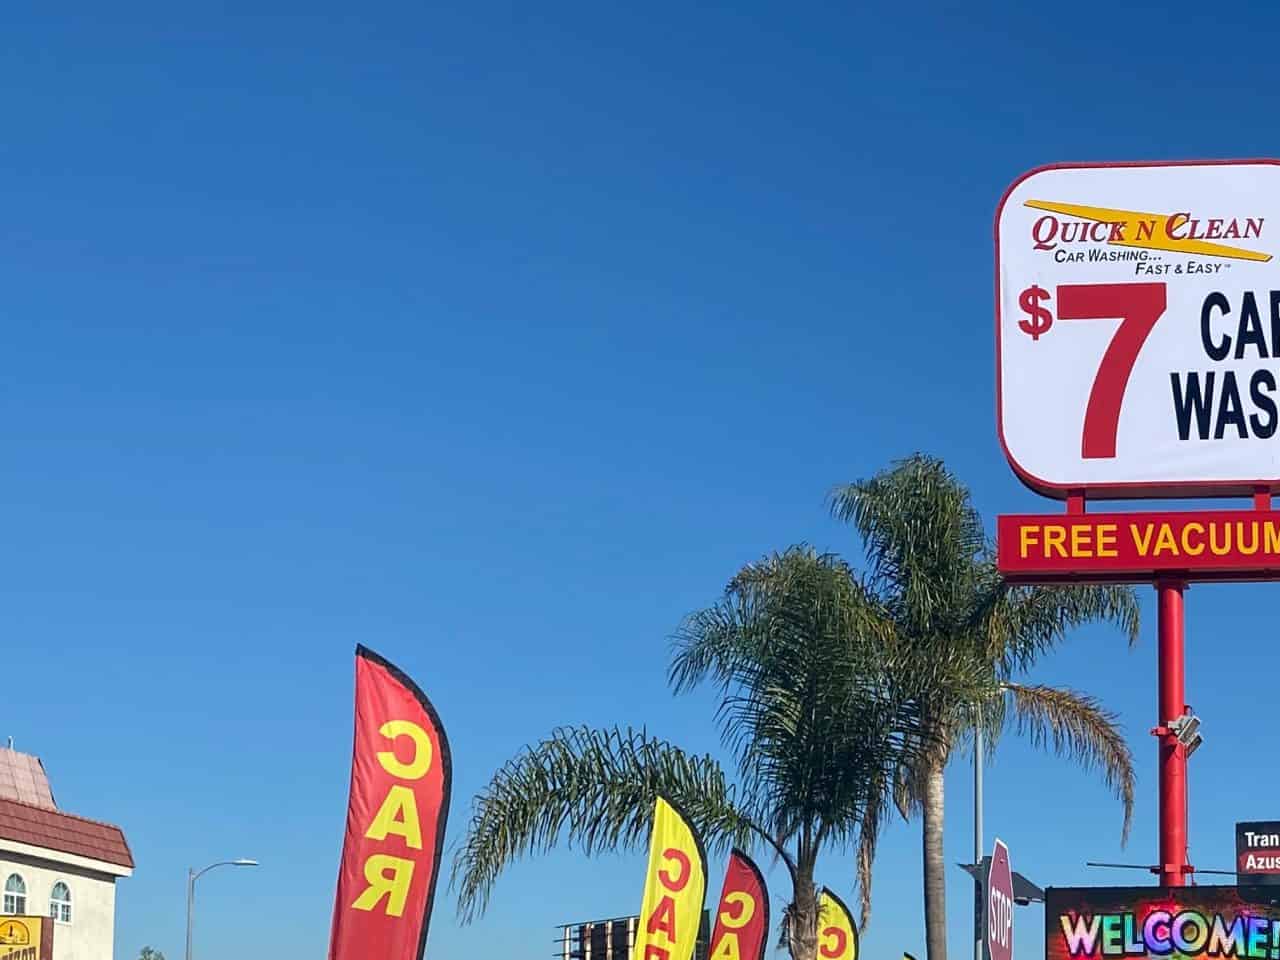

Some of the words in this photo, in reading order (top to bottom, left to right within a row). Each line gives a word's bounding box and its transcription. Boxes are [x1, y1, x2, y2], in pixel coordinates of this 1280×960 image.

[1031, 215, 1127, 250] QUICK
[1136, 220, 1156, 241] N
[1165, 212, 1264, 240] CLEAN
[1054, 249, 1084, 263] CAR
[1135, 262, 1169, 276] FAST
[1174, 264, 1182, 274] &
[1019, 523, 1119, 559] FREE
[990, 886, 1011, 949] STOP
